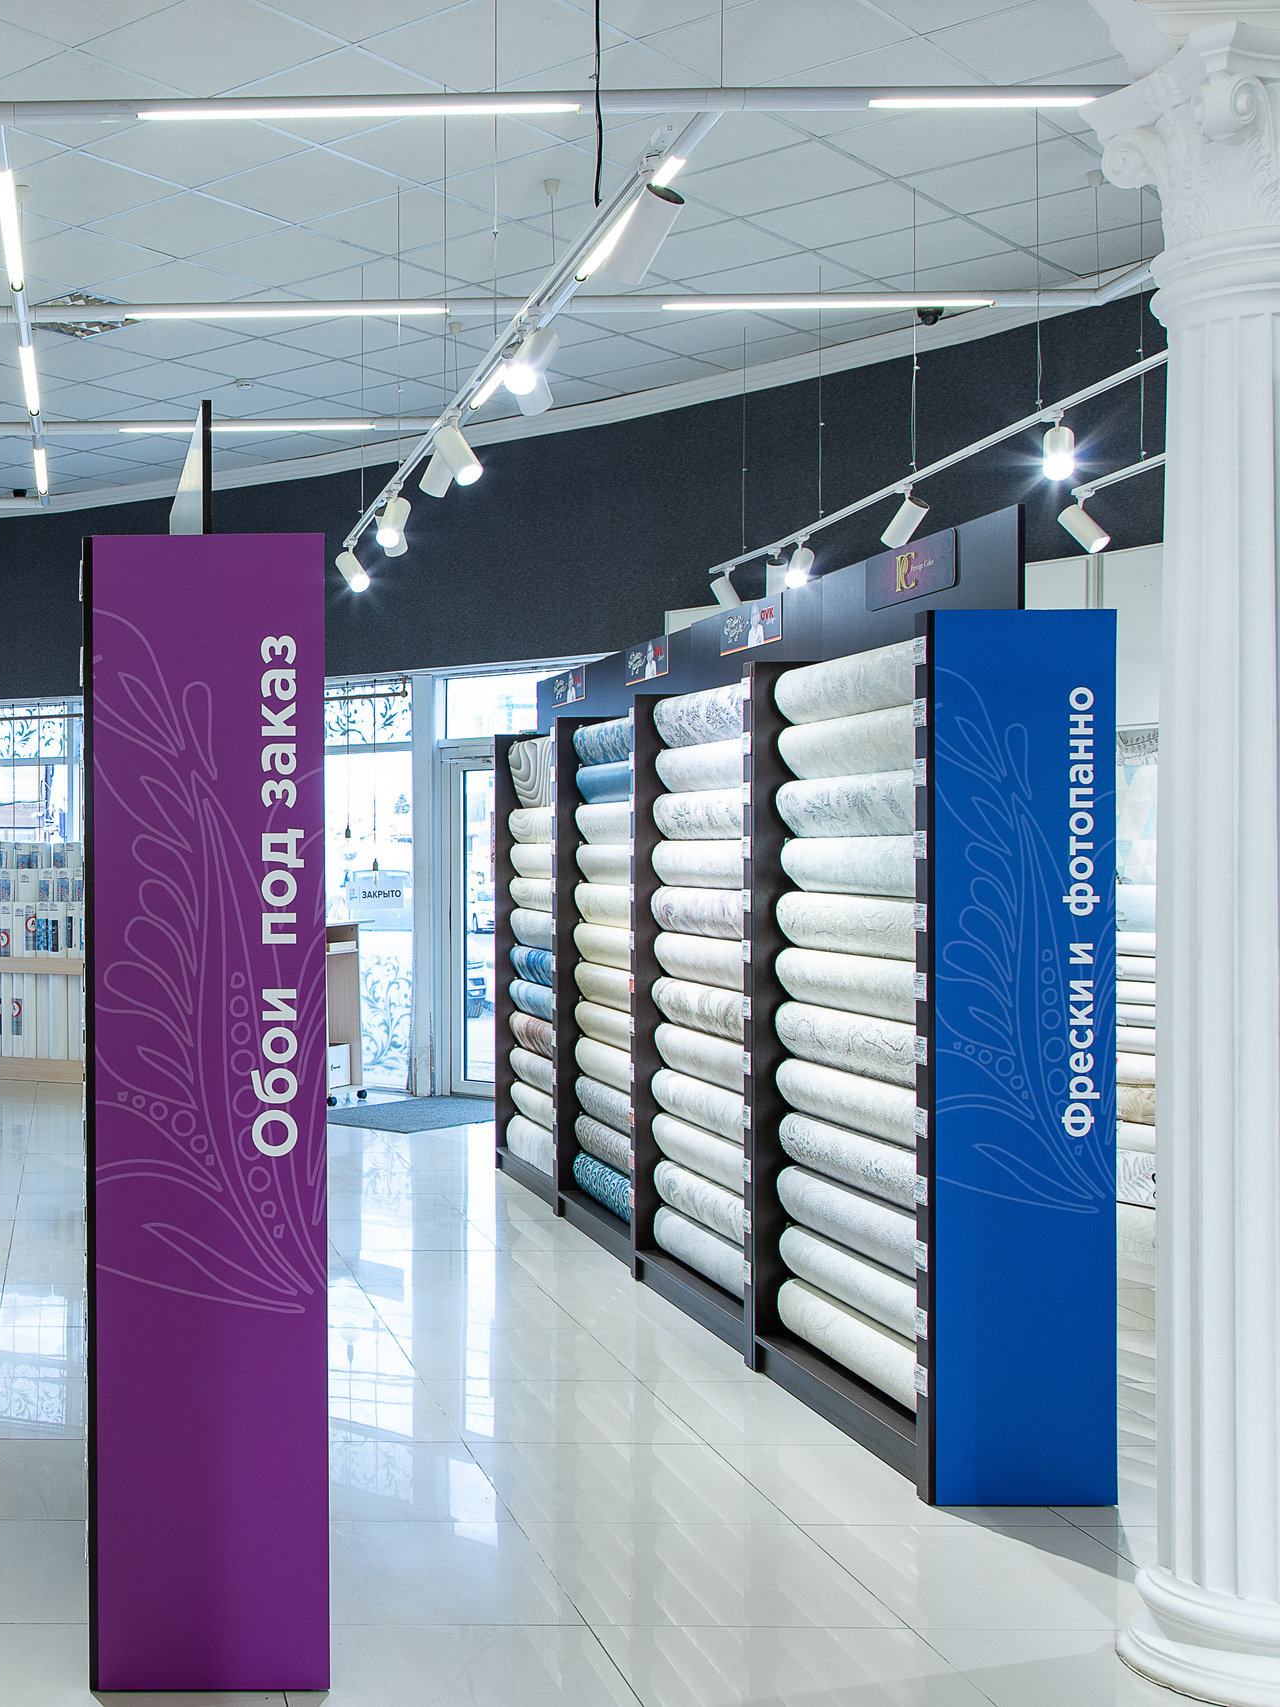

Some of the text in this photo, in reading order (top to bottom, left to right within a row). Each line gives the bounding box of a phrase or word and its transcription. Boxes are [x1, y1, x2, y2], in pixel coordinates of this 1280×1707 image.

[923, 558, 935, 568] Color
[760, 605, 775, 621] OVK
[251, 635, 305, 1157] Обои под заказ
[361, 889, 402, 899] ЗАКРЫТО
[1061, 686, 1100, 1138] Фрески и фотопанно
